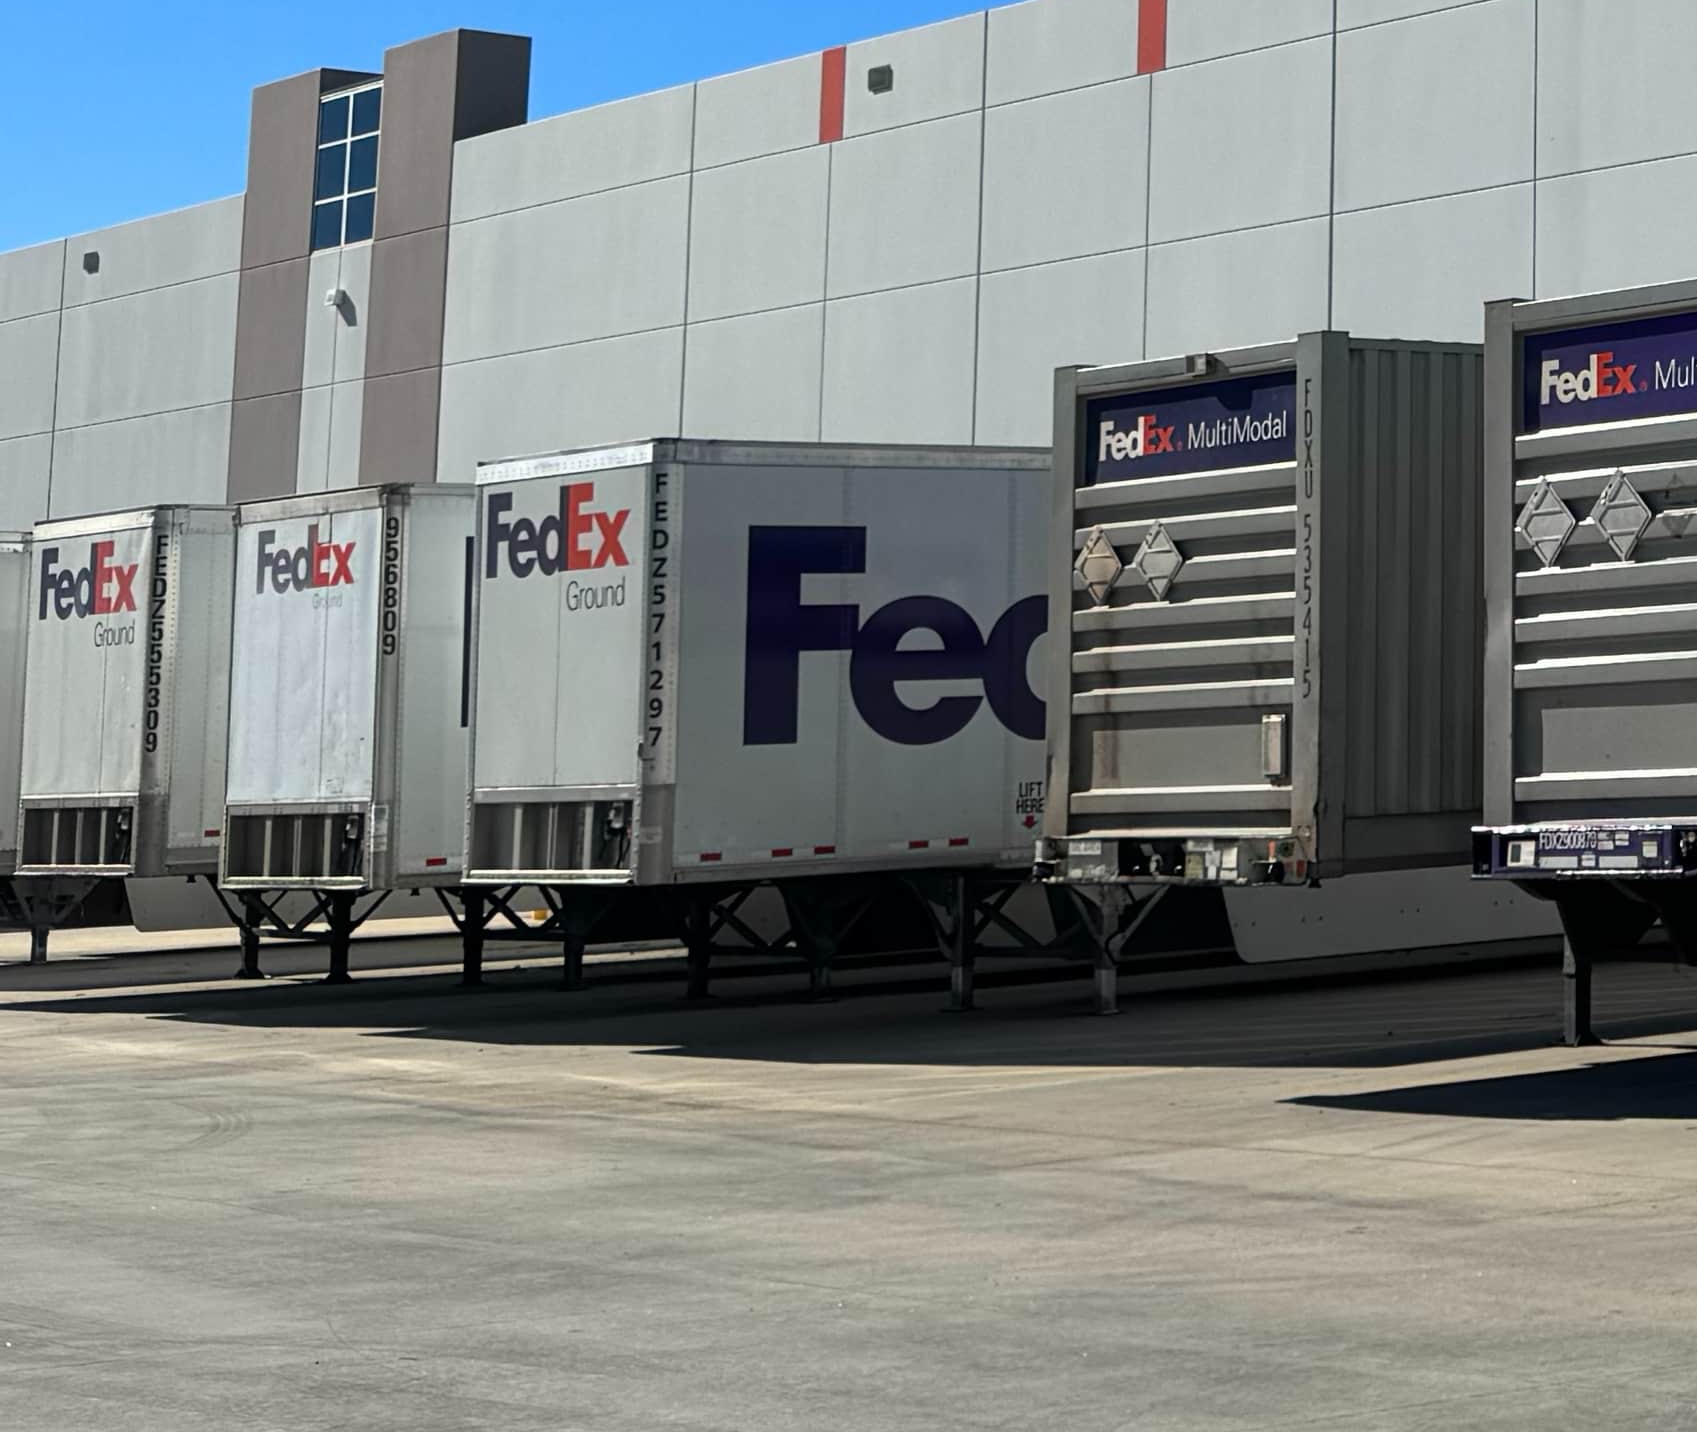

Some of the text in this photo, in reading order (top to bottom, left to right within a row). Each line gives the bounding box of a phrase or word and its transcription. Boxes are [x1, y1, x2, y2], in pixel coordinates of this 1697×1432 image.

[1540, 351, 1637, 406] FedEx
[1098, 410, 1287, 462] FedEx MultiModal
[255, 524, 357, 595] FedEx
[485, 481, 631, 579] FedEx
[1303, 379, 1314, 699] FDXU 535415
[38, 540, 139, 621] FedEx
[382, 517, 400, 656] 956809
[566, 576, 626, 612] Ground
[648, 472, 670, 747] FEDZ571297
[93, 620, 136, 648] Ground
[1016, 797, 1045, 814] HERE
[1019, 781, 1042, 798] LIFT
